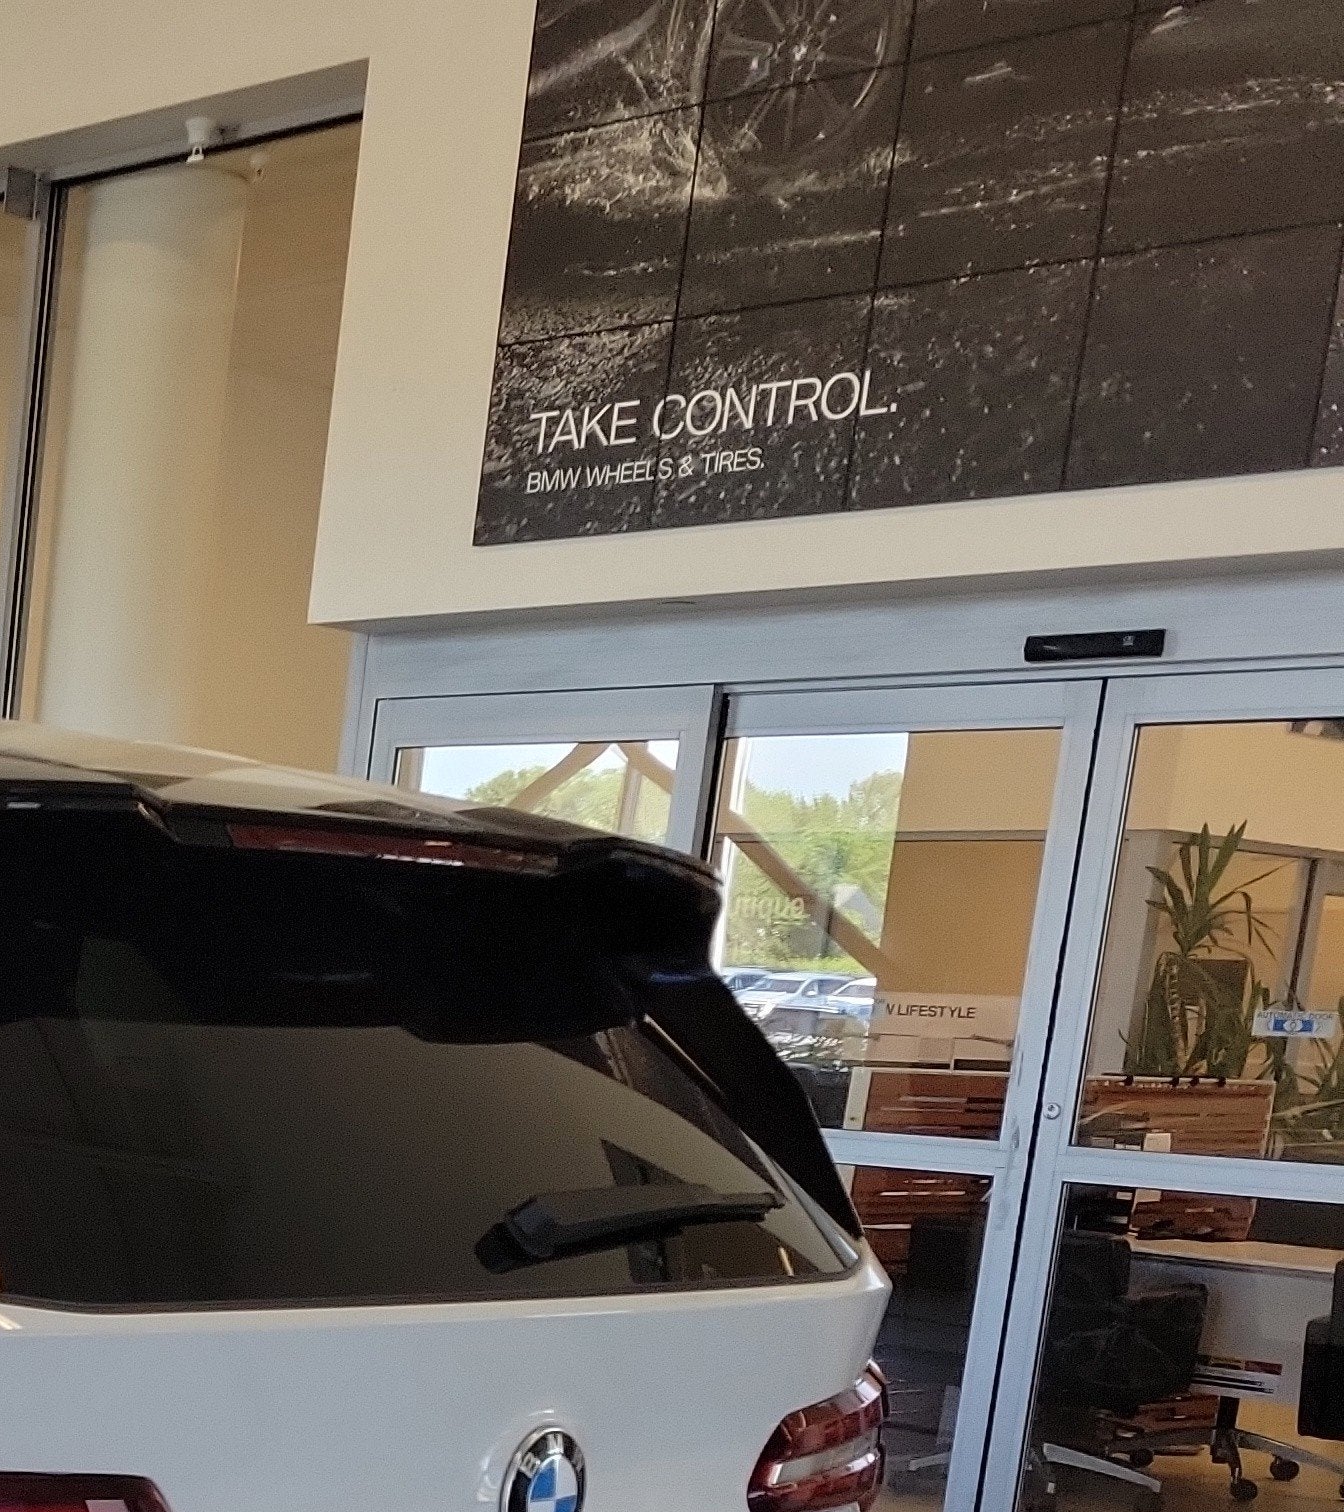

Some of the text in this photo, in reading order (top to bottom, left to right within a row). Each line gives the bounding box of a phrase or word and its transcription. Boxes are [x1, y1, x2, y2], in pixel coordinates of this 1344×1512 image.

[529, 370, 898, 454] TAKE CONTROL.
[526, 446, 765, 495] BMW WHEELS & TIRES.
[897, 1003, 978, 1019] LIFESTYLE
